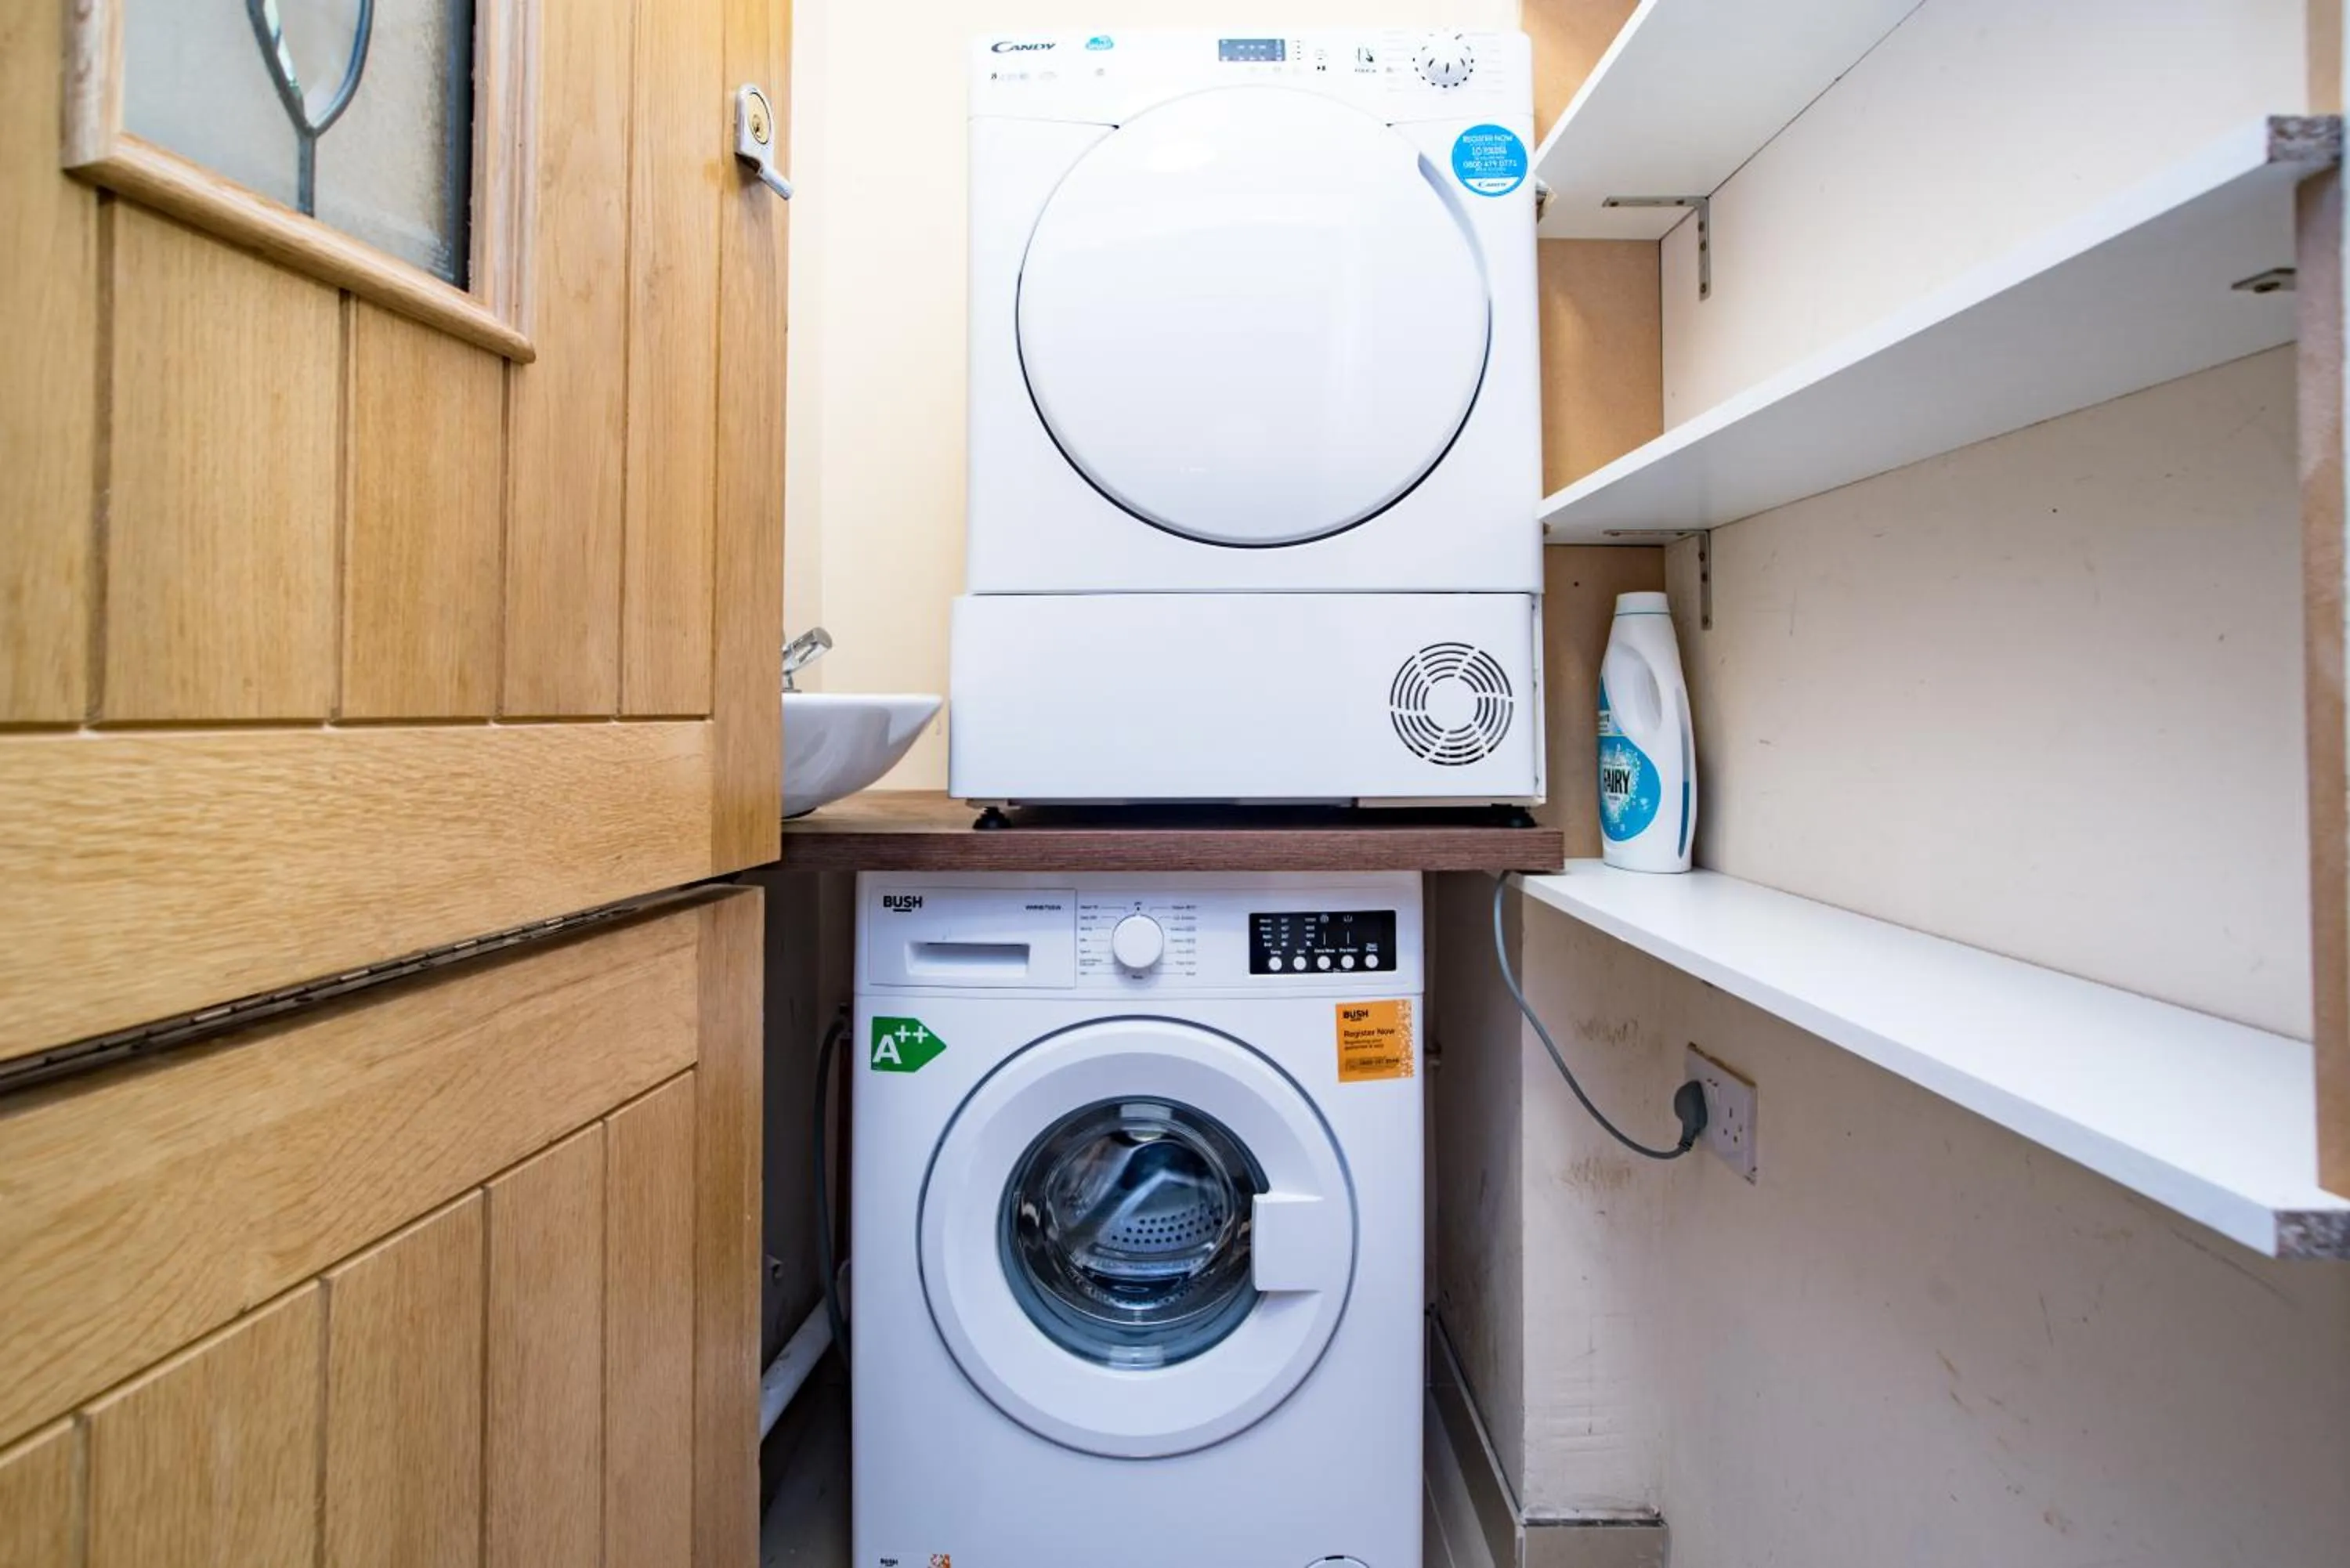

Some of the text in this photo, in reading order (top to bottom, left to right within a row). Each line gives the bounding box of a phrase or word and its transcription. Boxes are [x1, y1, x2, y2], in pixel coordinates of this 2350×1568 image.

[991, 42, 1056, 53] CANDY
[884, 895, 923, 909] BUSH
[1343, 1009, 1369, 1019] BUSH
[1343, 1029, 1375, 1038] Register
[872, 1024, 928, 1064] A++
